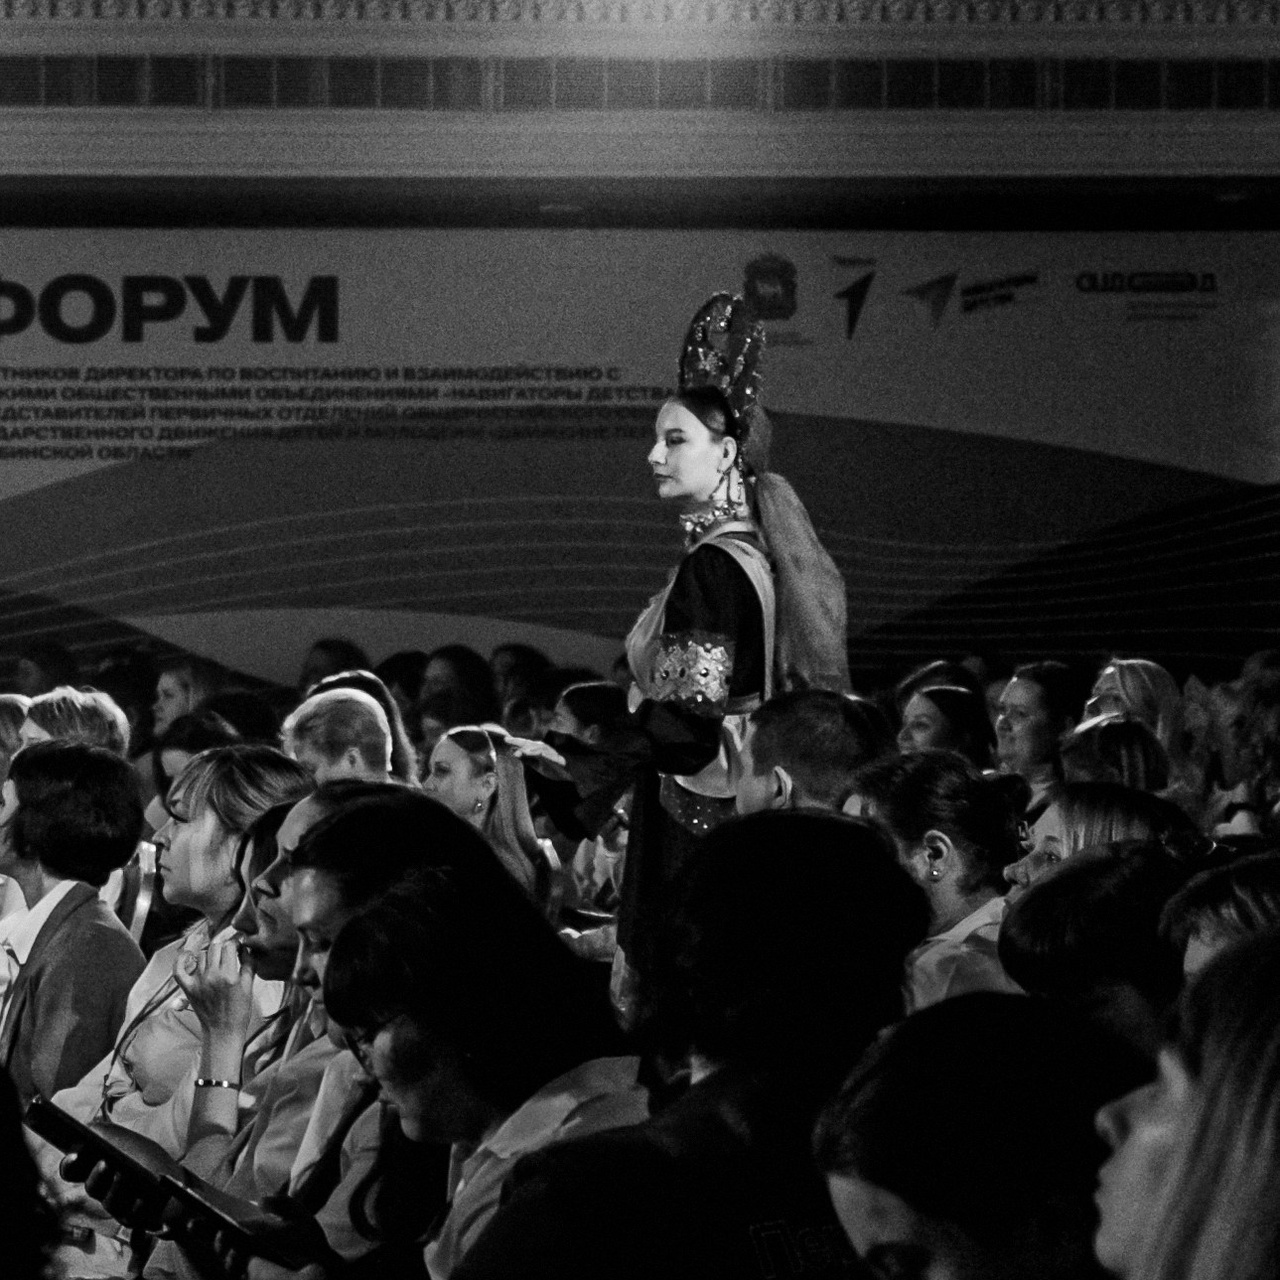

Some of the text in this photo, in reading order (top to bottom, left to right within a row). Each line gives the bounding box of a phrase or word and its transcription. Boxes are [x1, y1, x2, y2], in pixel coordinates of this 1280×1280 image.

[84, 365, 204, 382] ДИРЕКТОРА
[207, 365, 236, 382] ПО
[239, 365, 382, 382] ВОСПИТАНИЮ
[385, 365, 400, 382] И
[402, 365, 604, 382] ВЗАИМОДЕЙСТВИЮ
[606, 365, 622, 382] С
[60, 385, 252, 402] ОБЩЕСТВЕННЫМИ
[255, 385, 439, 402] ОБЪЕДИНЕНИЯМИ
[150, 404, 273, 421] ПЕРВИЧНЫХ
